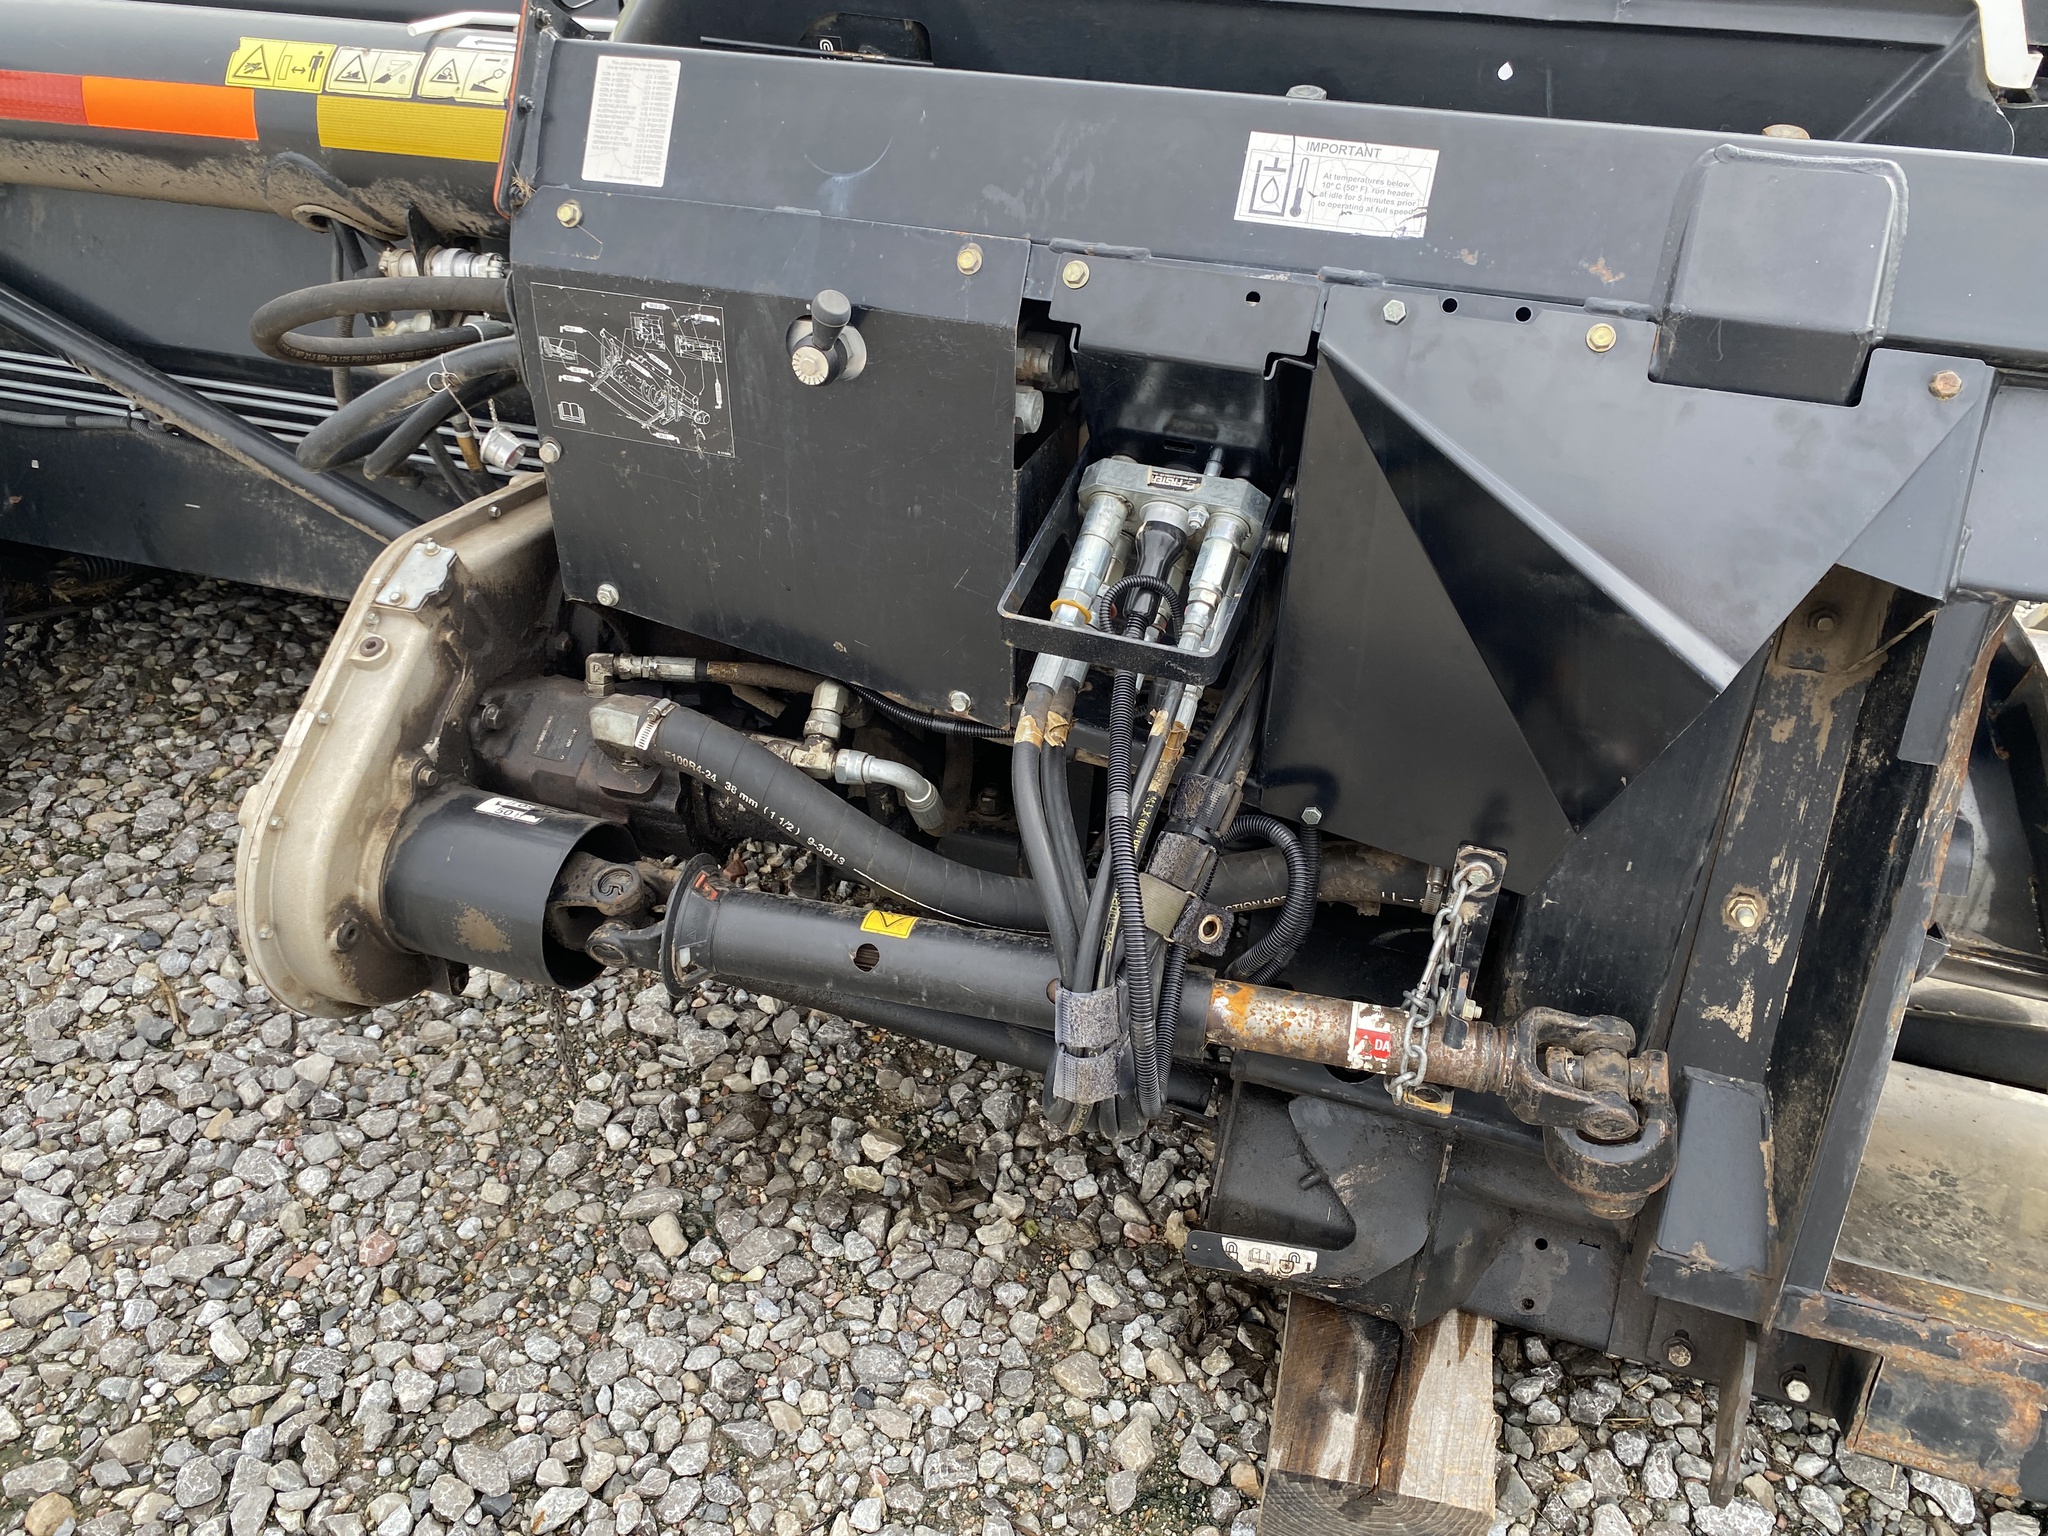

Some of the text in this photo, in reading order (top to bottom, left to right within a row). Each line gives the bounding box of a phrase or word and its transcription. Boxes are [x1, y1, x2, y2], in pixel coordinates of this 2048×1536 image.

[1306, 141, 1382, 158] IMPORTANT
[1322, 172, 1410, 188] At temperatures below
[1335, 182, 1342, 190] C
[1386, 188, 1414, 198] header
[1328, 191, 1343, 200] idle
[1344, 193, 1356, 201] for
[1358, 194, 1363, 202] 5
[1364, 196, 1395, 206] minutes
[1396, 198, 1417, 208] prior
[1328, 202, 1364, 213] operating
[1375, 206, 1388, 214] full
[724, 781, 737, 795] 38
[738, 791, 759, 809] mm
[495, 808, 513, 817] 50
[1134, 818, 1148, 838] (1/4)
